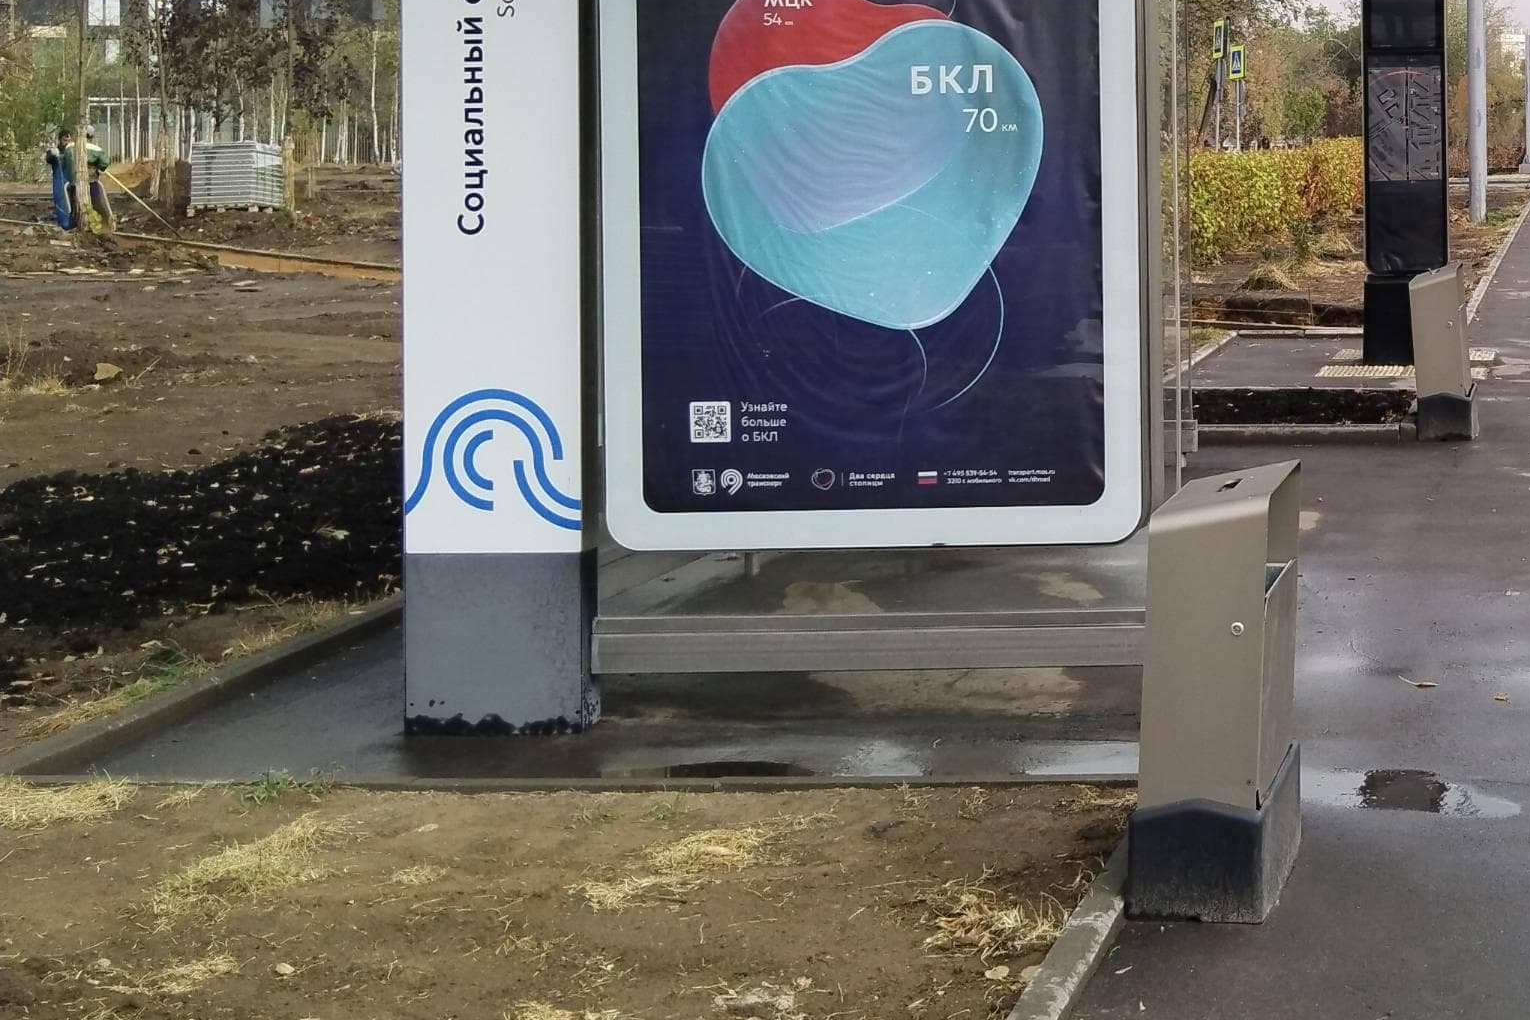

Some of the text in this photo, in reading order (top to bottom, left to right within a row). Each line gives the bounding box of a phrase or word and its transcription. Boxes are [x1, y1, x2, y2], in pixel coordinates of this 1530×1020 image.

[763, 12, 783, 26] 54
[911, 64, 993, 95] БКЛ
[456, 17, 488, 236] Социальный
[962, 107, 1018, 133] 70 км
[740, 401, 788, 413] Узнайте
[741, 415, 787, 427] больше
[742, 431, 778, 442] о БКЛ
[848, 472, 865, 481] Два
